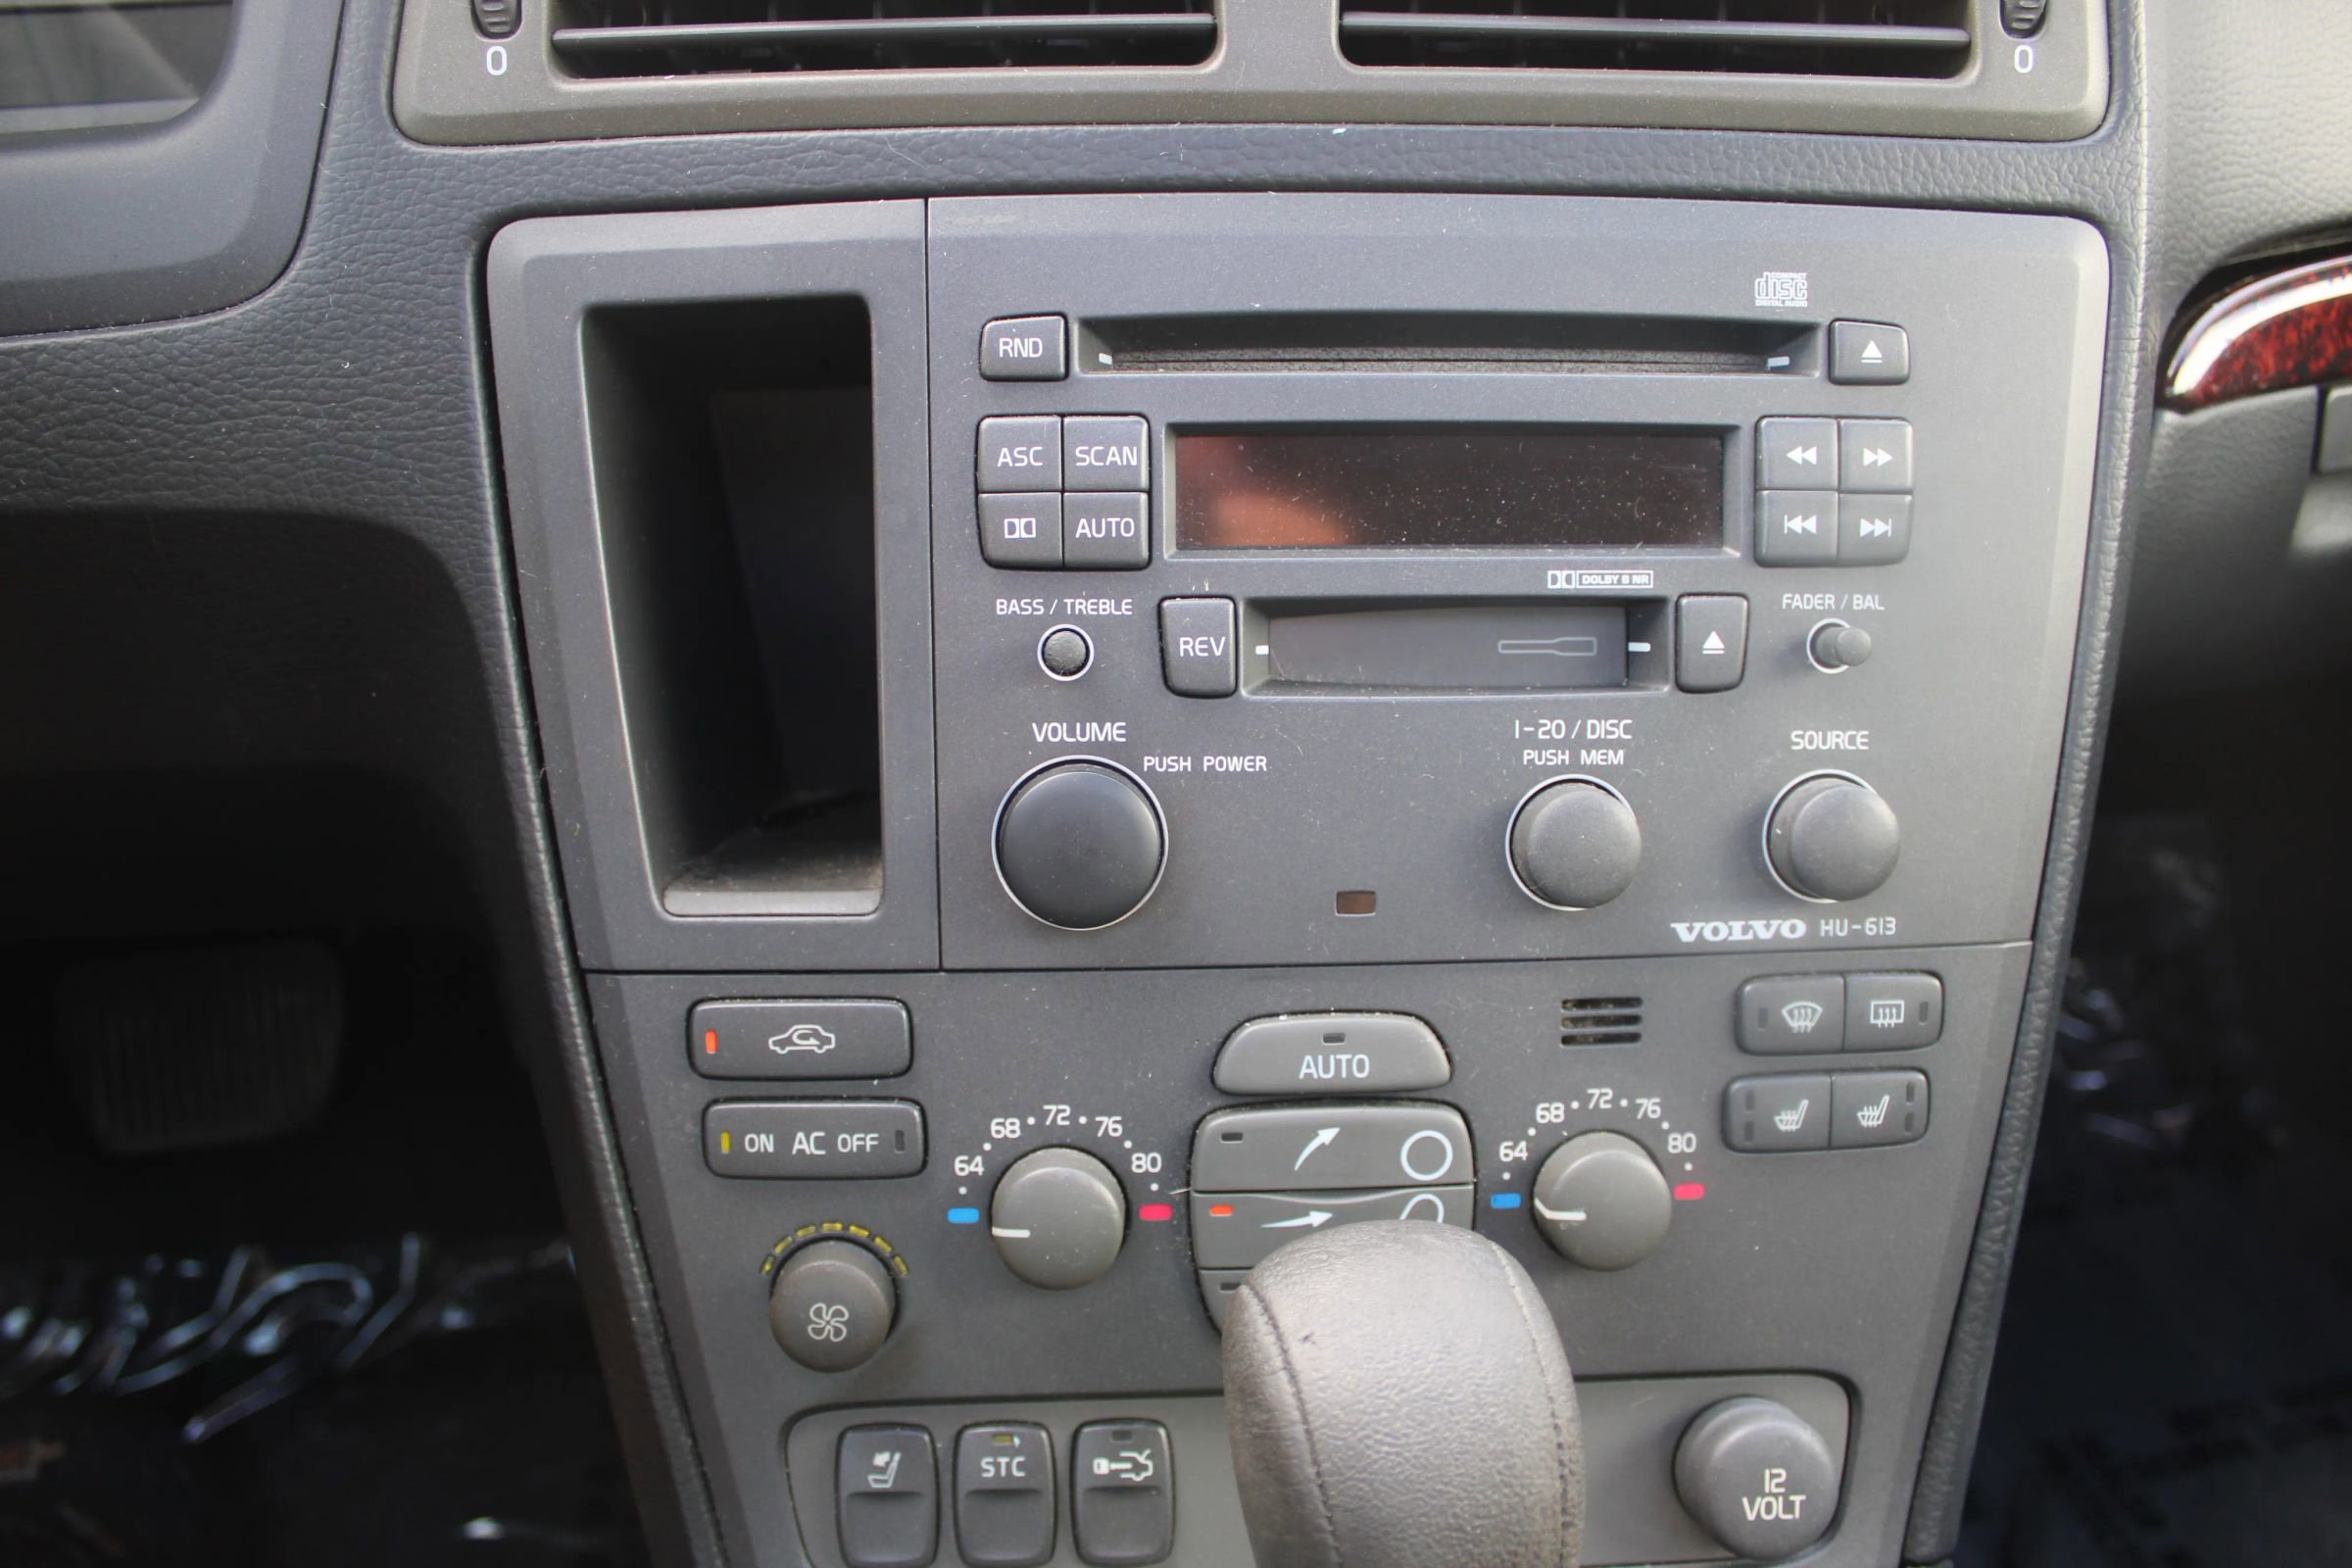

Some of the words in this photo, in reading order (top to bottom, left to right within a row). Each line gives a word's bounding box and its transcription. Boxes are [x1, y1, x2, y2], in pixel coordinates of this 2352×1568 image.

[486, 45, 508, 76] 0
[2013, 44, 2034, 74] 0
[999, 336, 1043, 359] RND
[997, 446, 1044, 467] ASC
[1075, 446, 1138, 467] SCAN
[1075, 517, 1135, 539] AUTO
[1582, 574, 1620, 585] DOLBY
[1621, 574, 1631, 585] B
[1632, 574, 1650, 585] NR
[996, 598, 1045, 615] BASS
[1063, 598, 1133, 615] TREBLE
[1782, 593, 1836, 611] FADER
[1853, 593, 1886, 612] BAL
[1179, 636, 1226, 658] REV
[1032, 721, 1127, 743] VOLUME
[1587, 719, 1633, 740] DISC
[1789, 729, 1870, 751] SOURCE
[1143, 755, 1192, 773] PUSH
[1202, 755, 1268, 773] POWER
[1522, 749, 1570, 766] PUSH
[1580, 749, 1624, 766] MEM
[1671, 918, 1807, 943] VOLVO
[1820, 916, 1897, 938] HU-613
[1298, 1054, 1370, 1080] AUTO
[1498, 1140, 1528, 1161] 64
[1535, 1102, 1565, 1124] 68
[1587, 1088, 1614, 1109] 72
[1635, 1098, 1661, 1120] 76
[1667, 1132, 1696, 1154] 80
[744, 1133, 774, 1153] ON
[791, 1131, 826, 1155] AC
[837, 1133, 879, 1152] OFF
[954, 1155, 985, 1176] 64
[990, 1118, 1021, 1140] 68
[1042, 1104, 1071, 1126] 72
[1095, 1116, 1123, 1138] 76
[1131, 1152, 1162, 1174] 80
[980, 1455, 1026, 1479] STC
[1763, 1468, 1787, 1494] 12
[1741, 1494, 1806, 1521] VOLT
